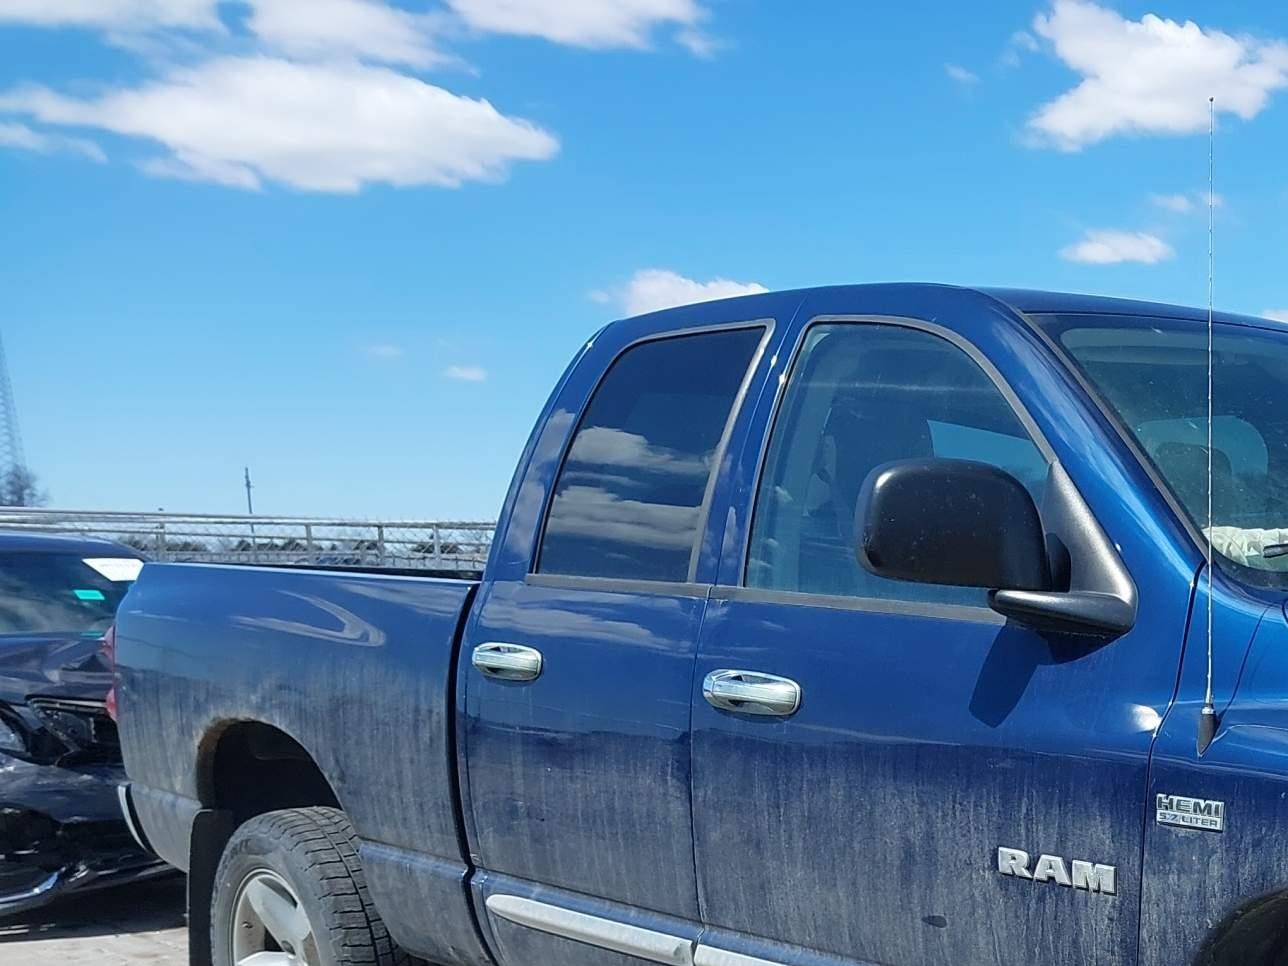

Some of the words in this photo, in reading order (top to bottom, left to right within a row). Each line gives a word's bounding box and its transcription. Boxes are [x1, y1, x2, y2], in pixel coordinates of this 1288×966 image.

[1157, 795, 1221, 817] HEMI
[1181, 815, 1221, 828] LITER
[997, 846, 1117, 896] RAM
